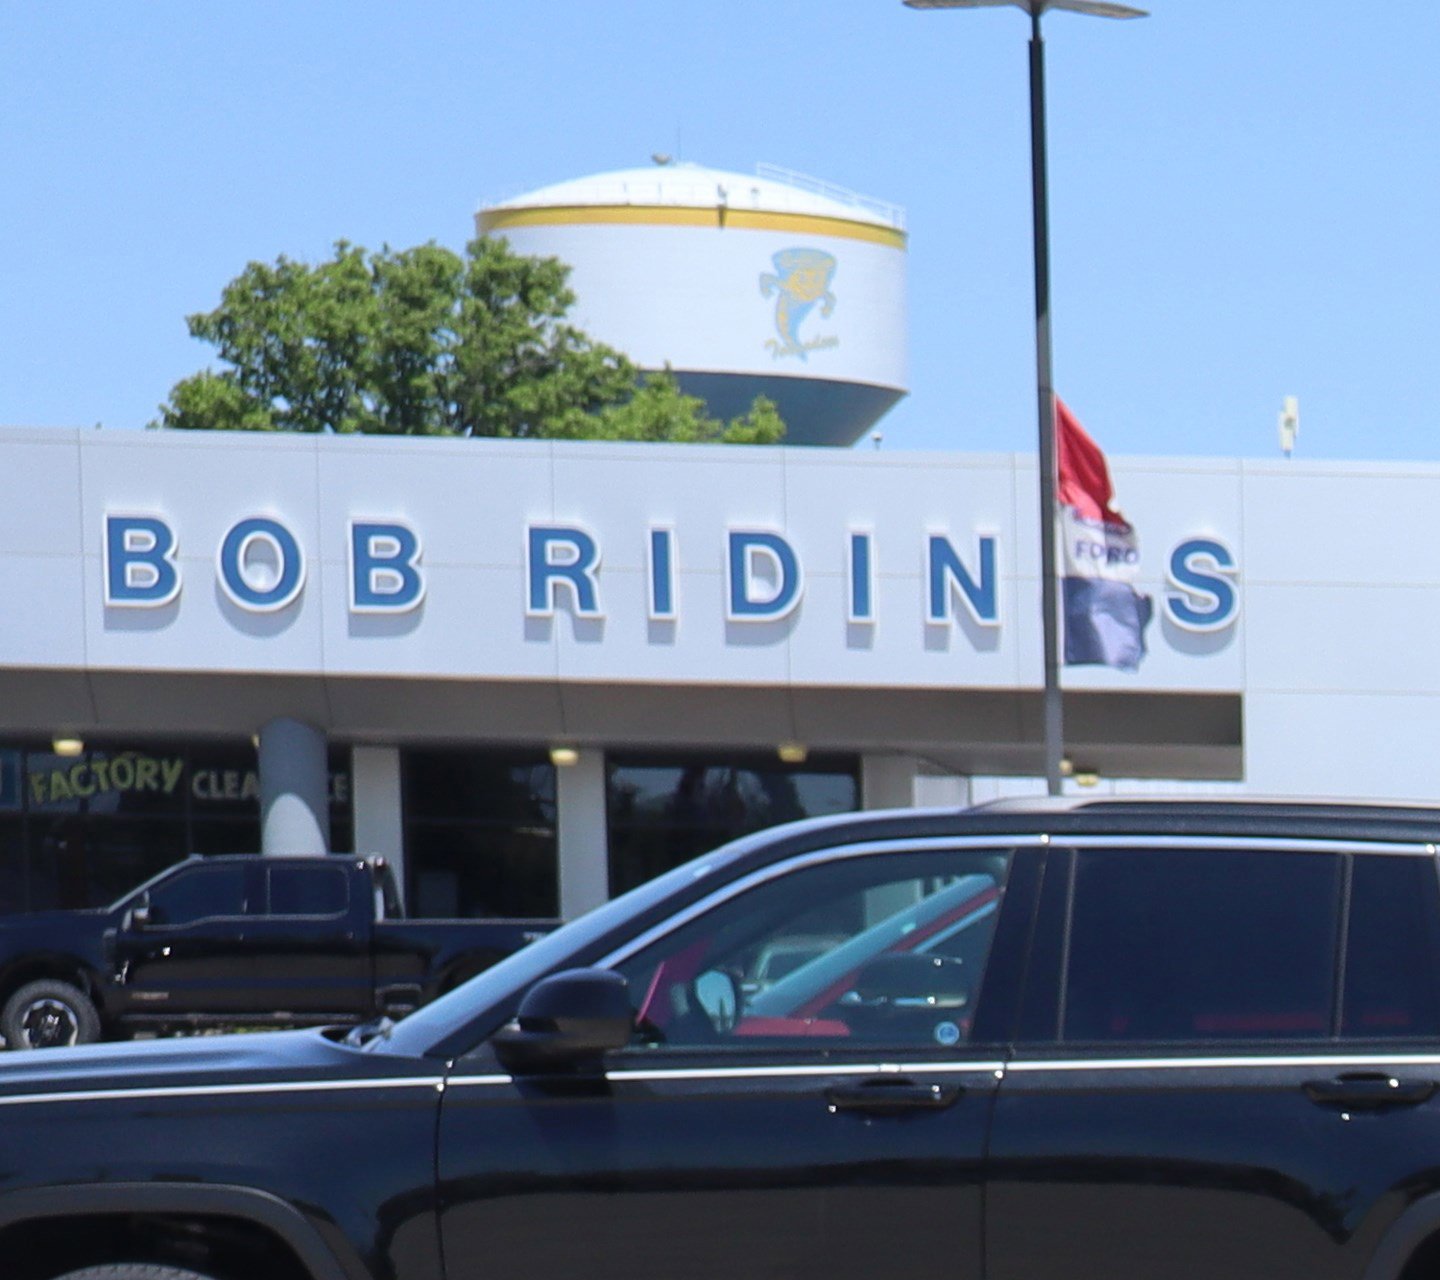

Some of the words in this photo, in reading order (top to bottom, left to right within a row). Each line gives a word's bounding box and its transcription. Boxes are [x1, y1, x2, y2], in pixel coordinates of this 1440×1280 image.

[104, 514, 427, 613] BOB
[524, 525, 1240, 630] RIDINS
[1076, 541, 1139, 565] FORD
[27, 757, 185, 804] FACTORY
[192, 771, 352, 801] CLEAE
